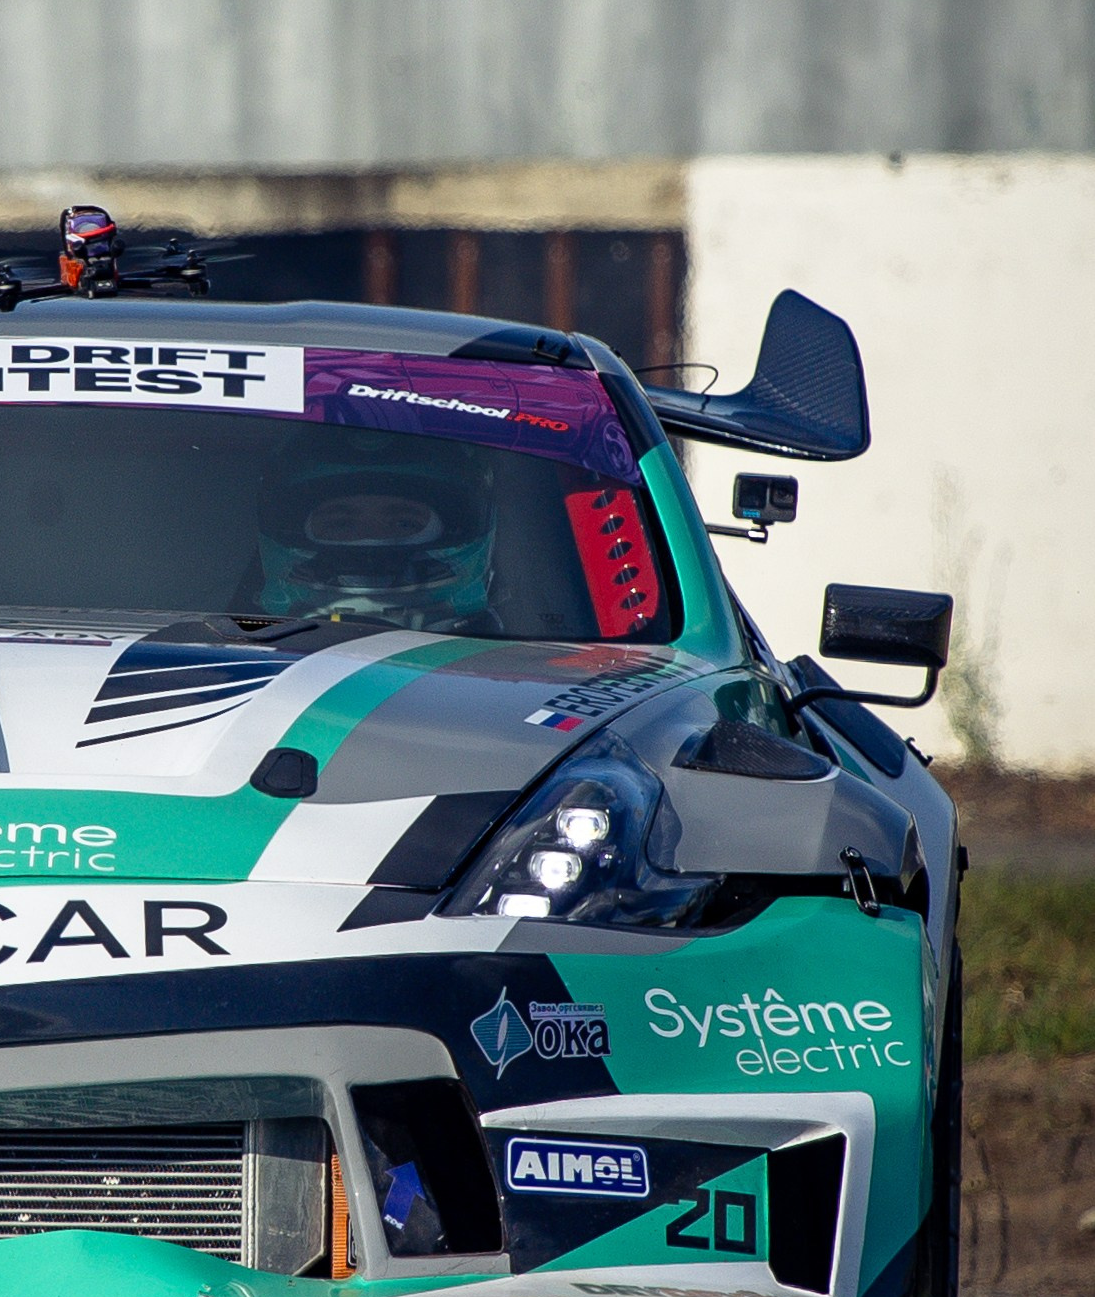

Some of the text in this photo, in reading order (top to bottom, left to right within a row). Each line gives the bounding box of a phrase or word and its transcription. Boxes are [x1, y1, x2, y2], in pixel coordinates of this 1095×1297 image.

[11, 345, 266, 370] DRIFT
[644, 988, 893, 1047] Système
[736, 1037, 912, 1075] electric
[665, 1188, 757, 1256] 20
